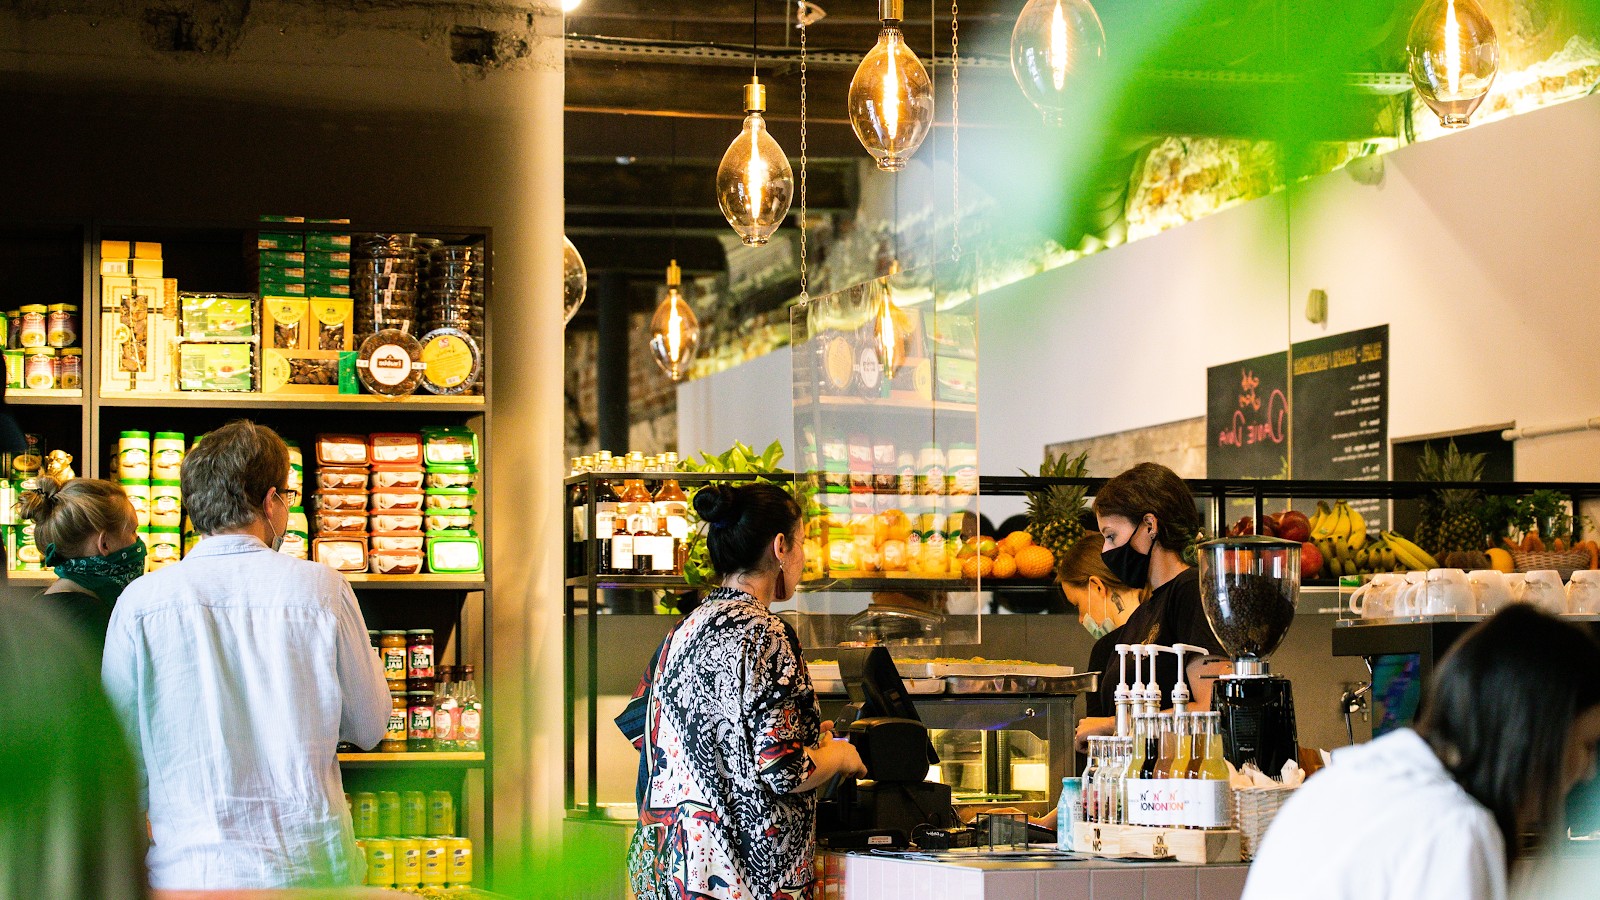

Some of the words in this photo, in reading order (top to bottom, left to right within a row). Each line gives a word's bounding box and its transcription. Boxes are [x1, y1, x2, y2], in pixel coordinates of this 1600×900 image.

[386, 661, 402, 669] JAM
[413, 658, 428, 666] JAM
[388, 722, 404, 730] JAM
[414, 719, 430, 727] JAM
[1093, 828, 1101, 840] TO
